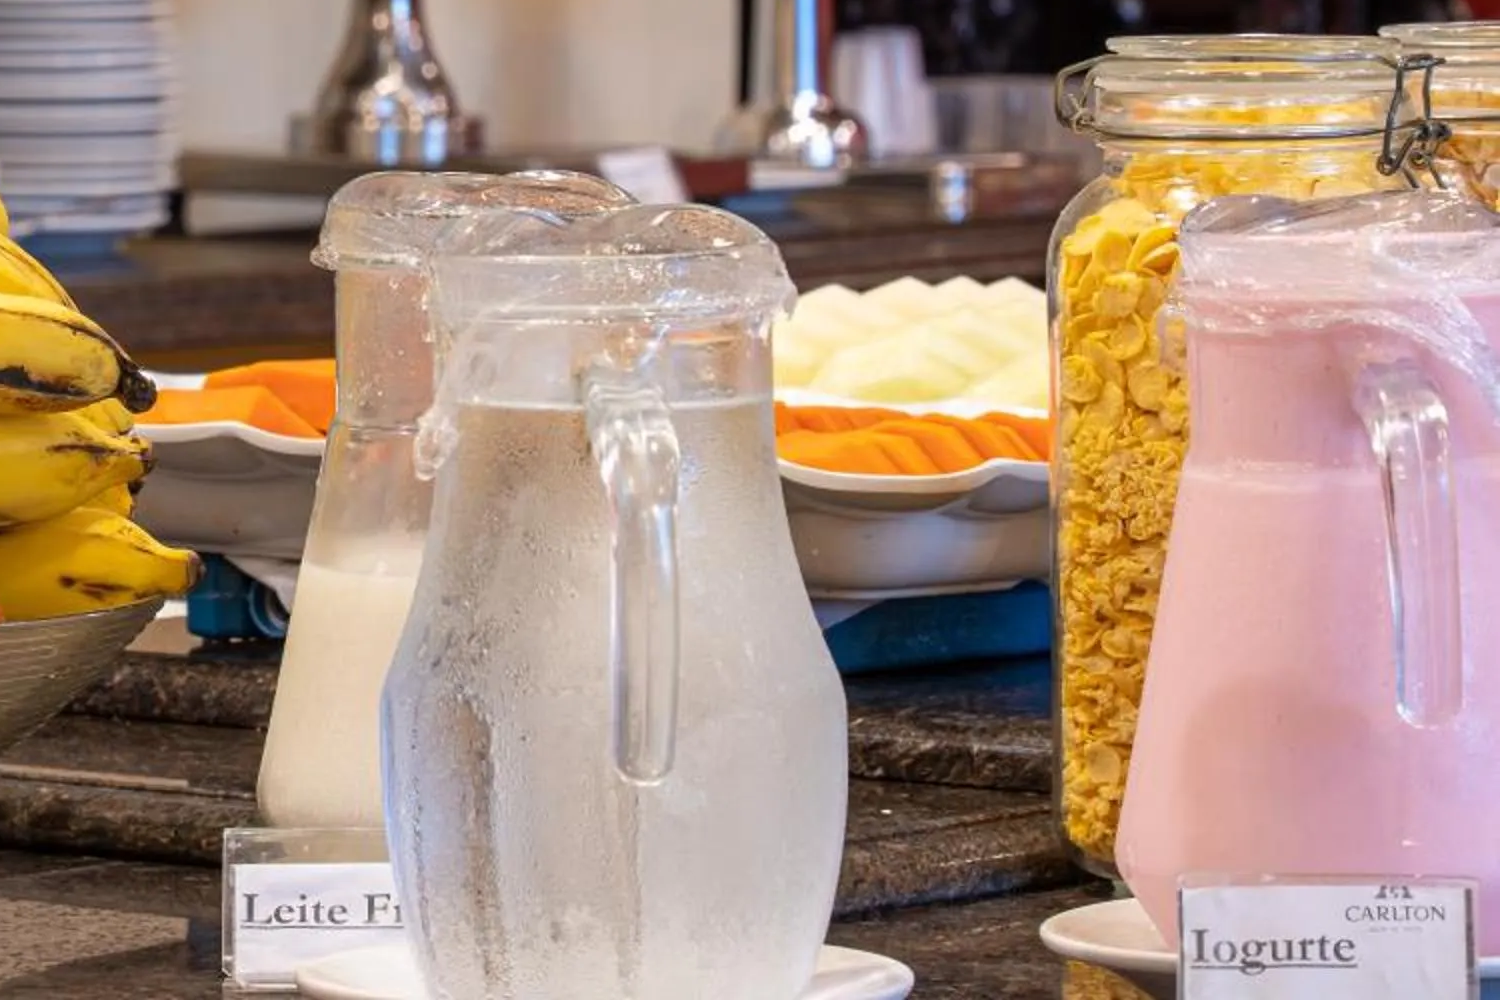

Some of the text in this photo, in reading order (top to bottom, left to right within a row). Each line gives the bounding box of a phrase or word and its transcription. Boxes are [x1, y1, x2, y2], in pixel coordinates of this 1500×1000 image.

[242, 893, 348, 924] Leite
[1345, 905, 1446, 923] CARLTON
[1190, 929, 1356, 975] Iogurte
